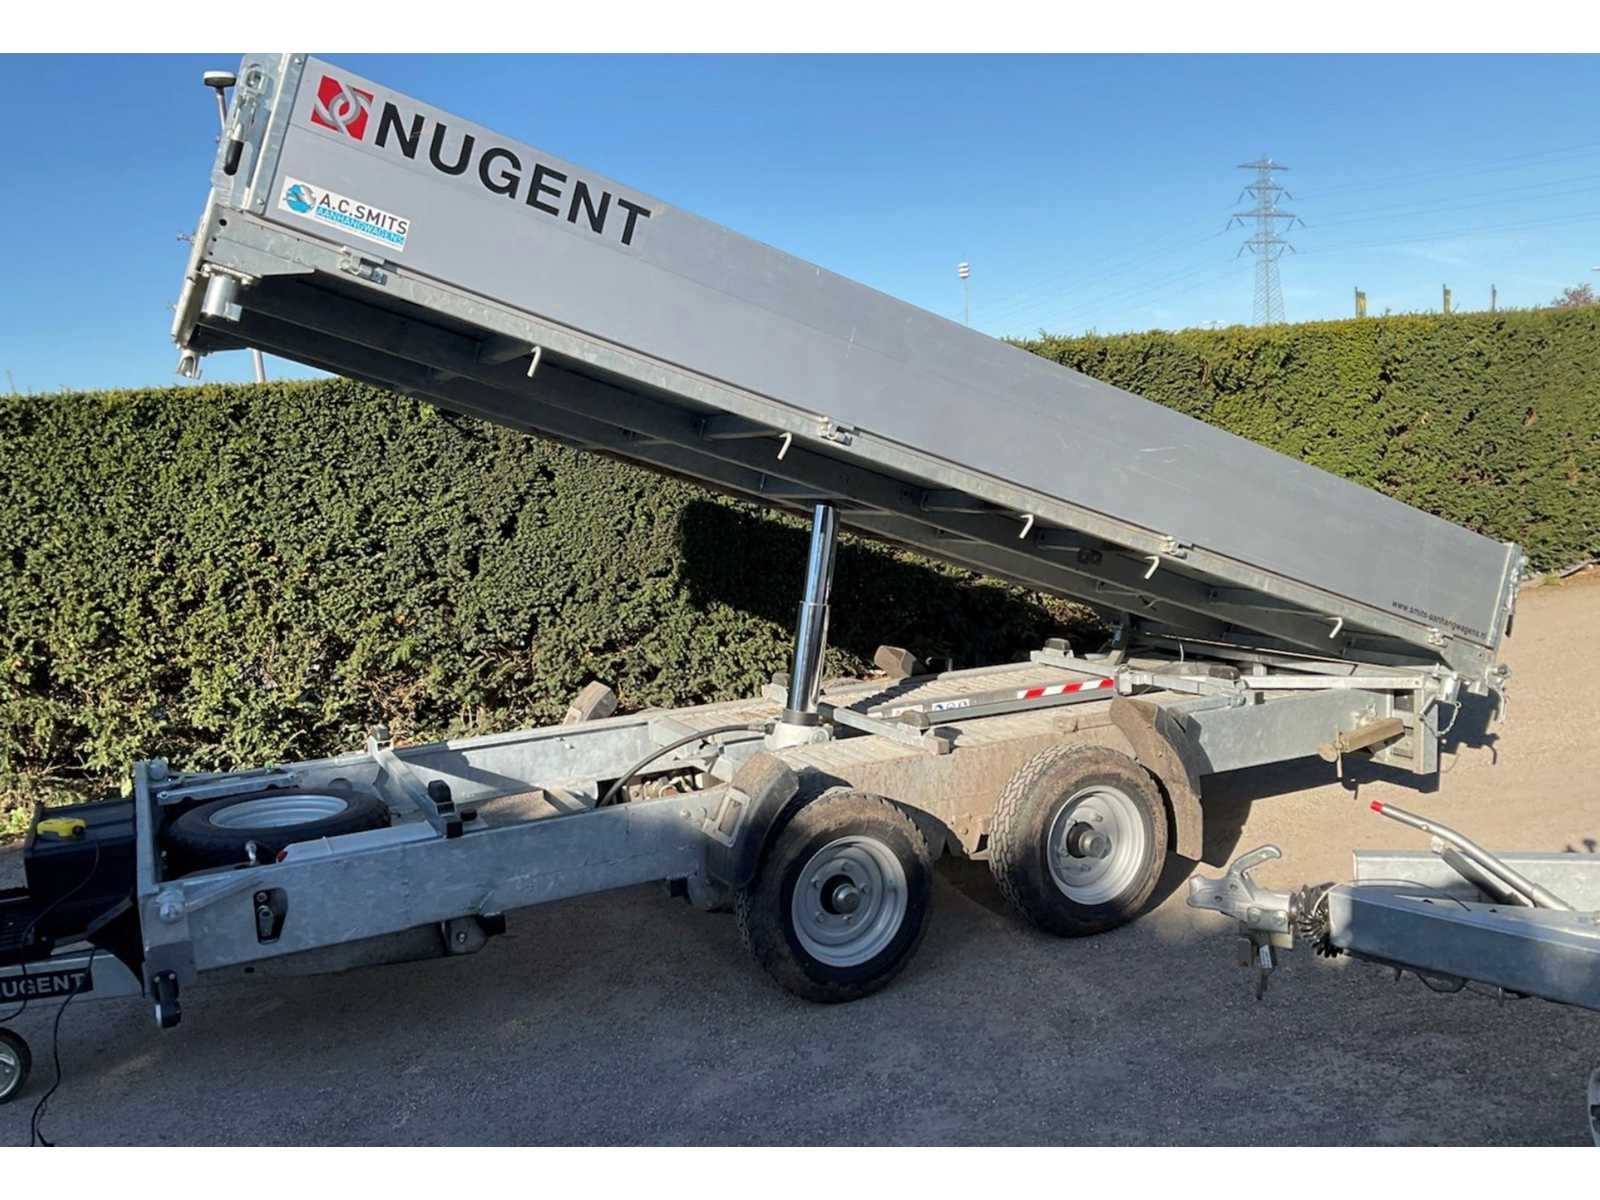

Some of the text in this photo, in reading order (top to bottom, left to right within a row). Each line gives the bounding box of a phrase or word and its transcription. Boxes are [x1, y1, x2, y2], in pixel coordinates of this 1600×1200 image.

[374, 101, 651, 246] NUGENT
[316, 206, 406, 245] AANHANGWAGENS
[320, 193, 408, 235] A.C.SMITS
[0, 973, 85, 998] UGENT
